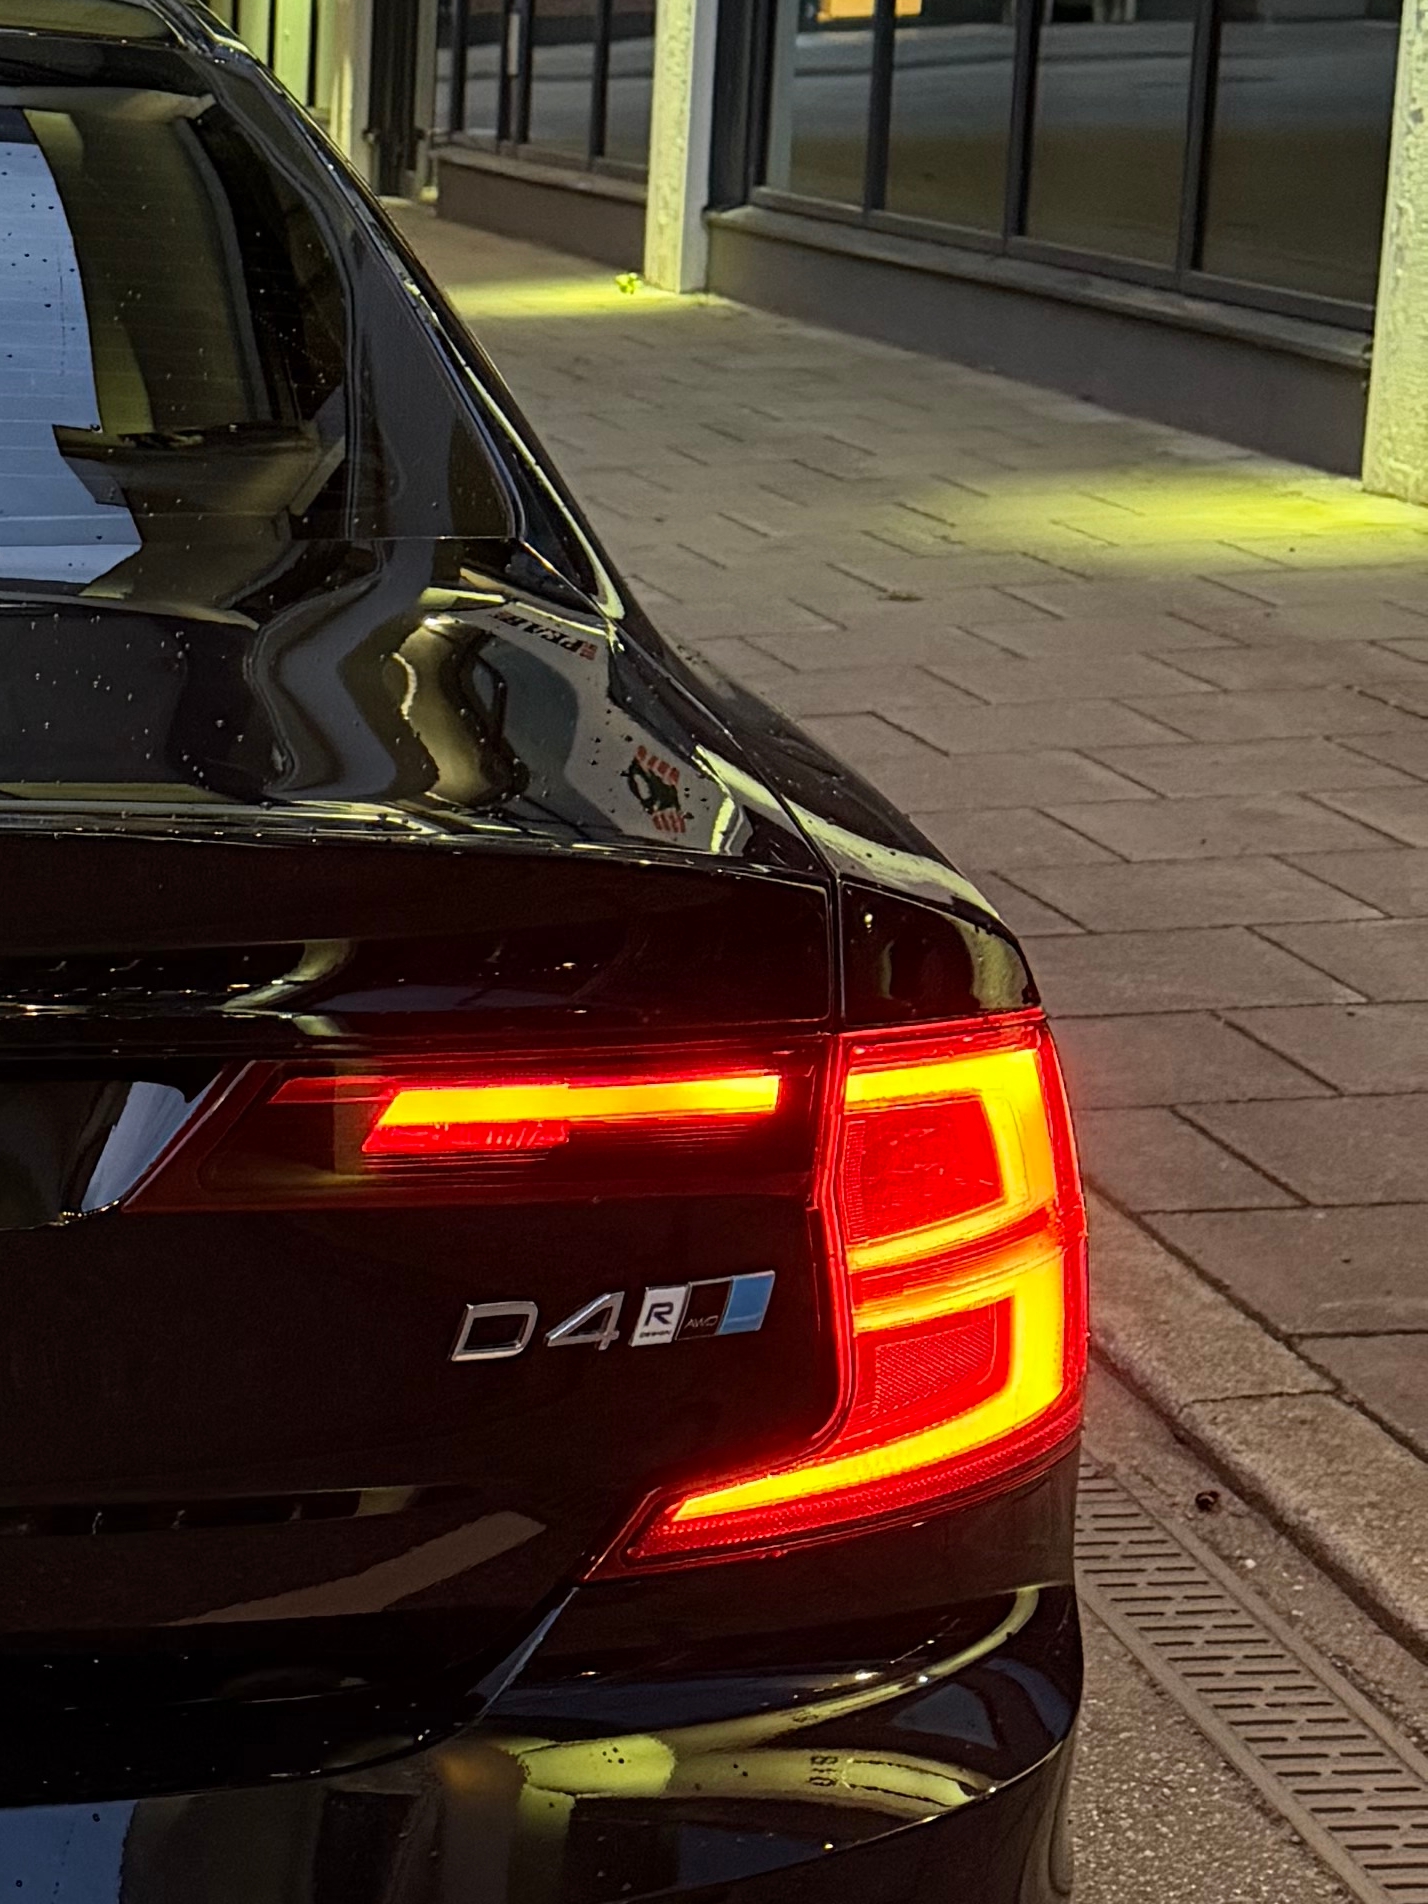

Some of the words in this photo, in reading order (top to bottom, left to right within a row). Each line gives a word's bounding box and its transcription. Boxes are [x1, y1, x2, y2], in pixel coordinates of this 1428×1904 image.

[449, 1290, 626, 1361] D4
[644, 1301, 674, 1327] R
[684, 1315, 719, 1330] AWD
